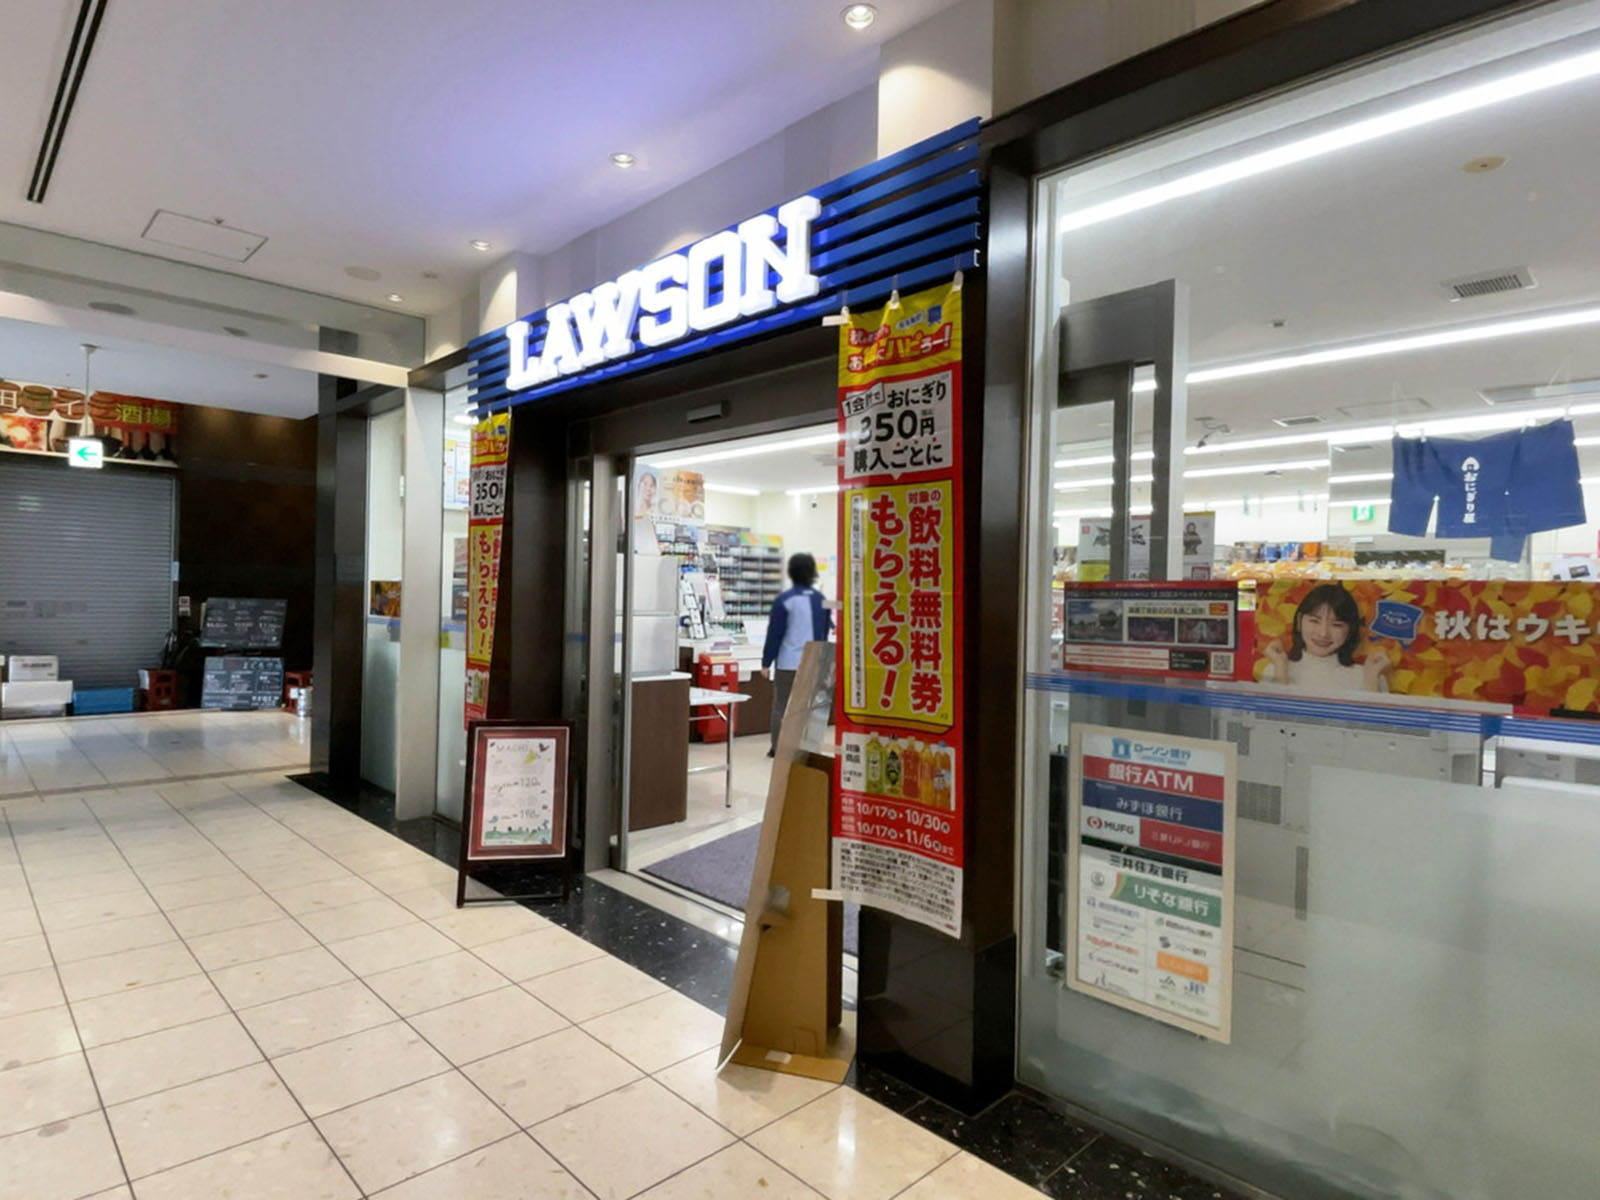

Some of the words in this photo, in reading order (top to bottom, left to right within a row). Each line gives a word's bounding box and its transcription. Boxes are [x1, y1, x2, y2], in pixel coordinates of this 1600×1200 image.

[506, 195, 821, 391] LAWSON
[887, 380, 947, 409] おにぎり
[858, 409, 935, 445] 350円
[853, 444, 943, 473] 購入ごとに
[477, 530, 490, 655] もらえる!
[870, 494, 905, 709] もらえる!
[908, 506, 943, 713] 飲料無料券
[1434, 610, 1600, 645] 秋はウキ
[1134, 743, 1191, 761] ローソン銀行
[1108, 762, 1195, 793] 銀行ATM
[1116, 797, 1183, 821] みずほ銀行
[1104, 820, 1135, 835] MUFG
[1110, 854, 1189, 884] 三井住友銀行
[1134, 884, 1209, 916] りそな銀行
